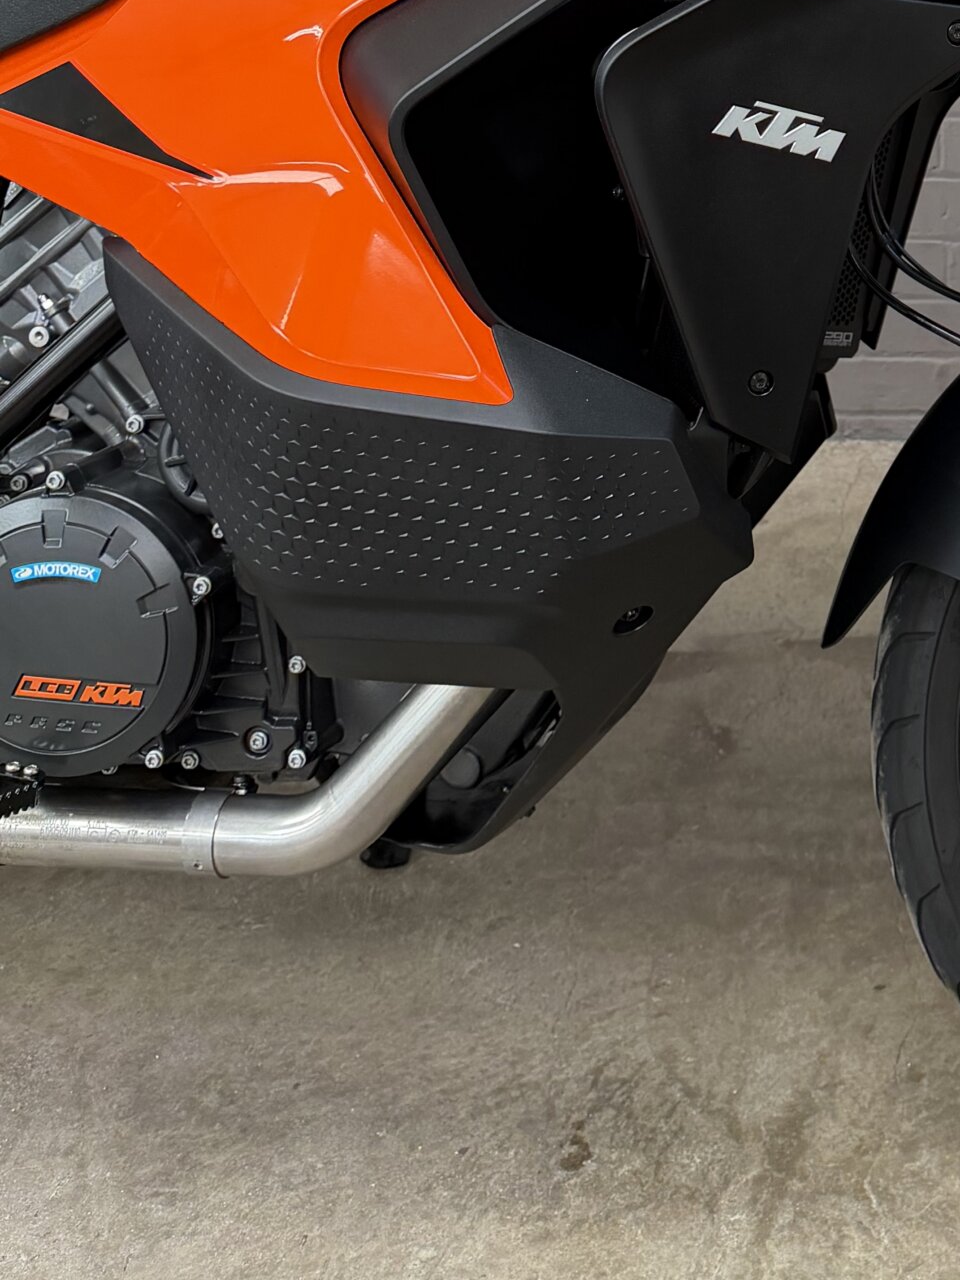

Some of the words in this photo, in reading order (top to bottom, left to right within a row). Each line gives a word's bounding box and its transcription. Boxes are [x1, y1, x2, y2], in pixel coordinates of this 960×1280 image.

[711, 100, 847, 163] KTM
[33, 563, 96, 580] MOTOREX
[80, 681, 145, 707] KTM
